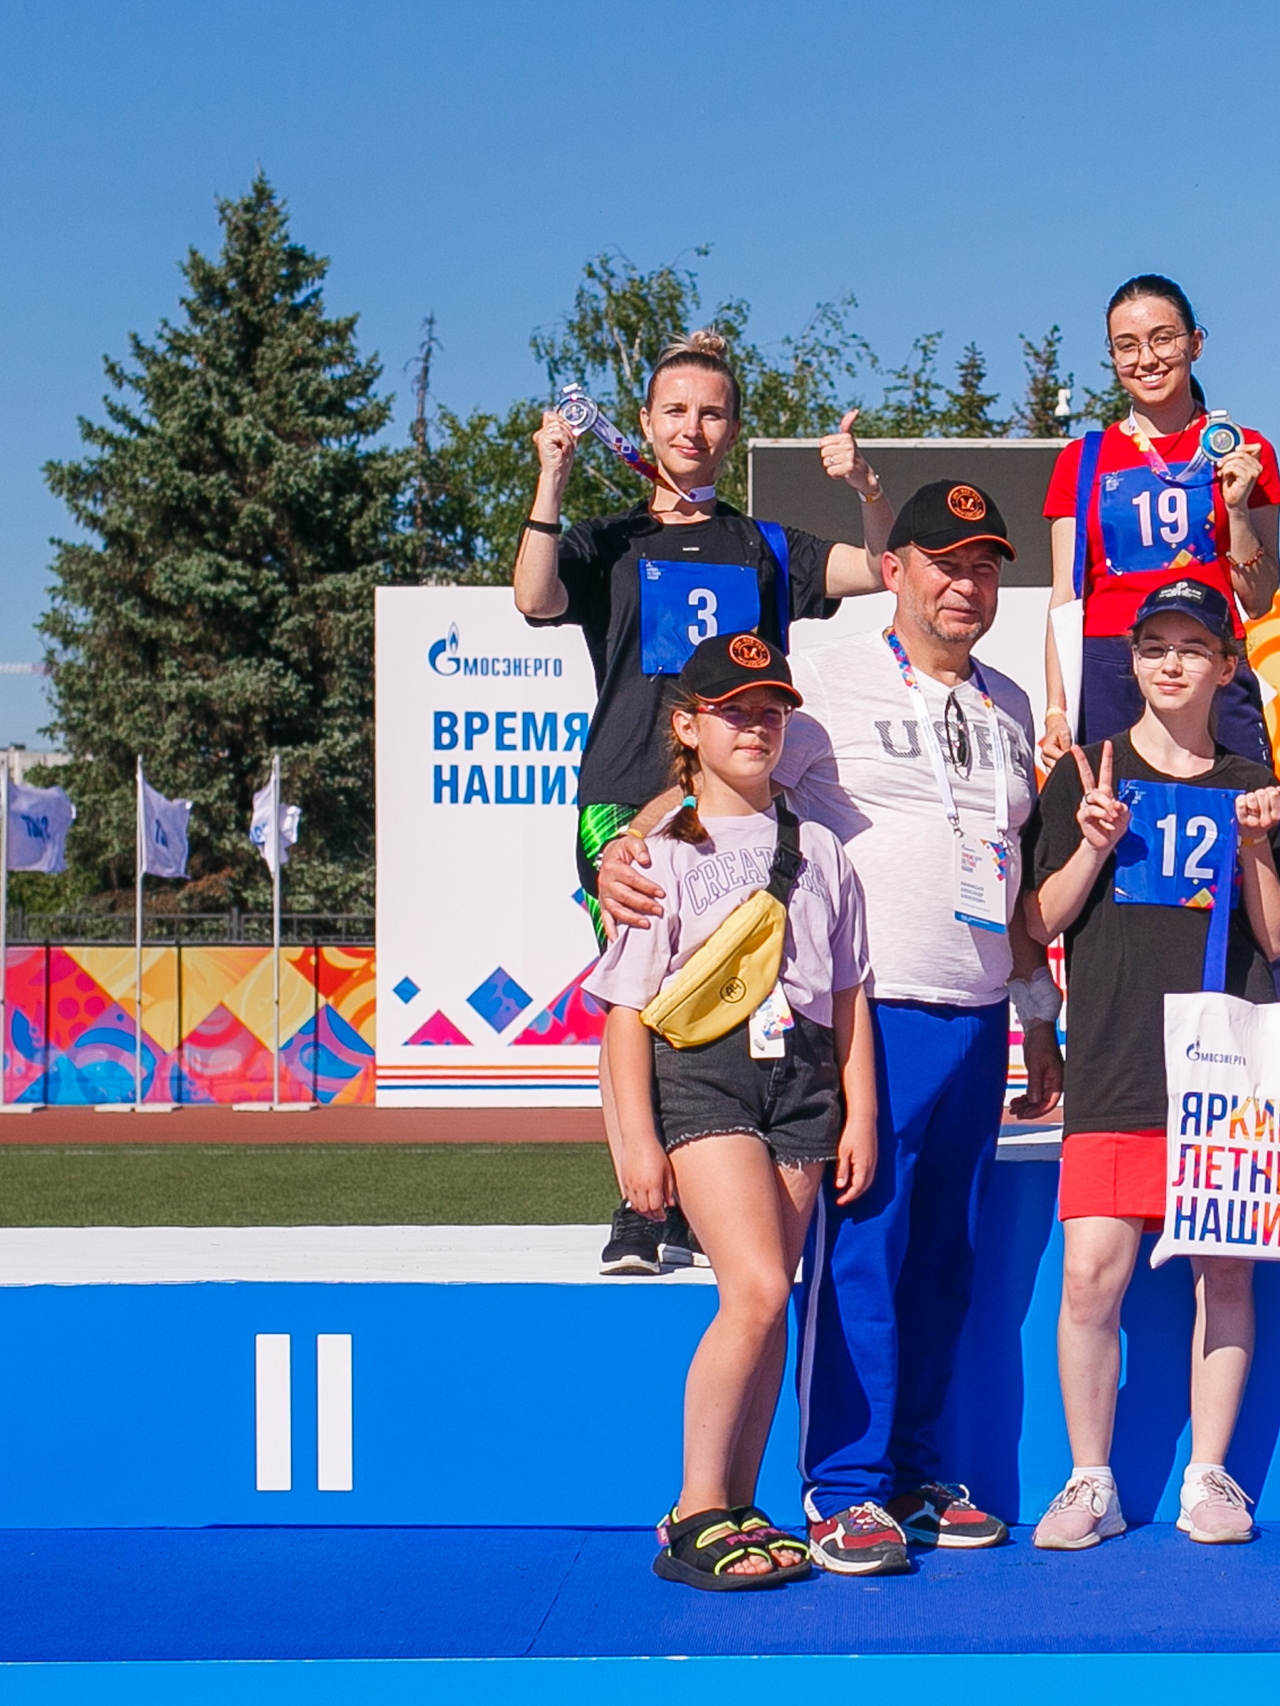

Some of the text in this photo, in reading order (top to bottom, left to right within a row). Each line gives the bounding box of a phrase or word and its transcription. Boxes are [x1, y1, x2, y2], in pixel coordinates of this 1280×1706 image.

[1131, 487, 1189, 547] 19
[688, 587, 718, 646] 3
[432, 711, 590, 751] ВРЕМЯ
[1156, 813, 1219, 880] 12
